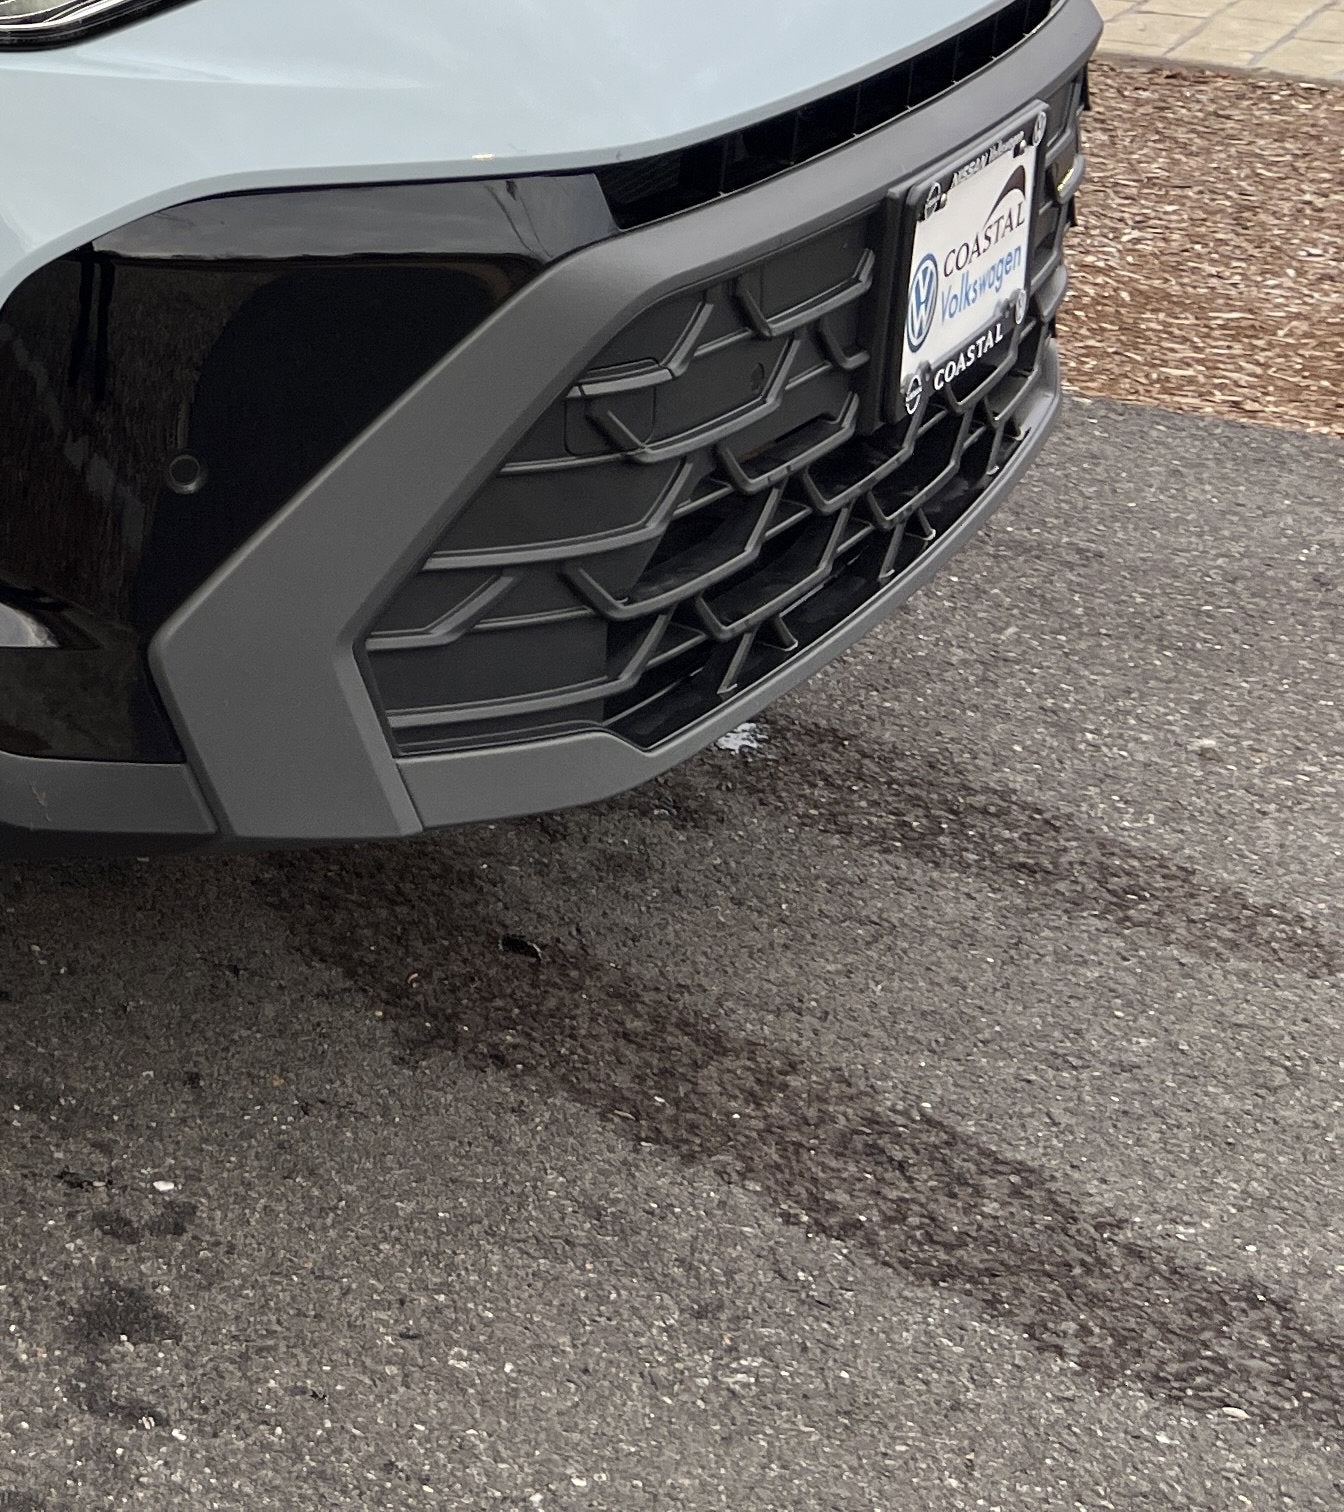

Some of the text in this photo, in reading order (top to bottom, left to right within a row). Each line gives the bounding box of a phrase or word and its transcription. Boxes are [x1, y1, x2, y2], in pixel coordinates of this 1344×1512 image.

[943, 203, 1026, 278] COASTAL
[940, 245, 1023, 323] Volkswagen
[933, 322, 1005, 392] COASTAL
